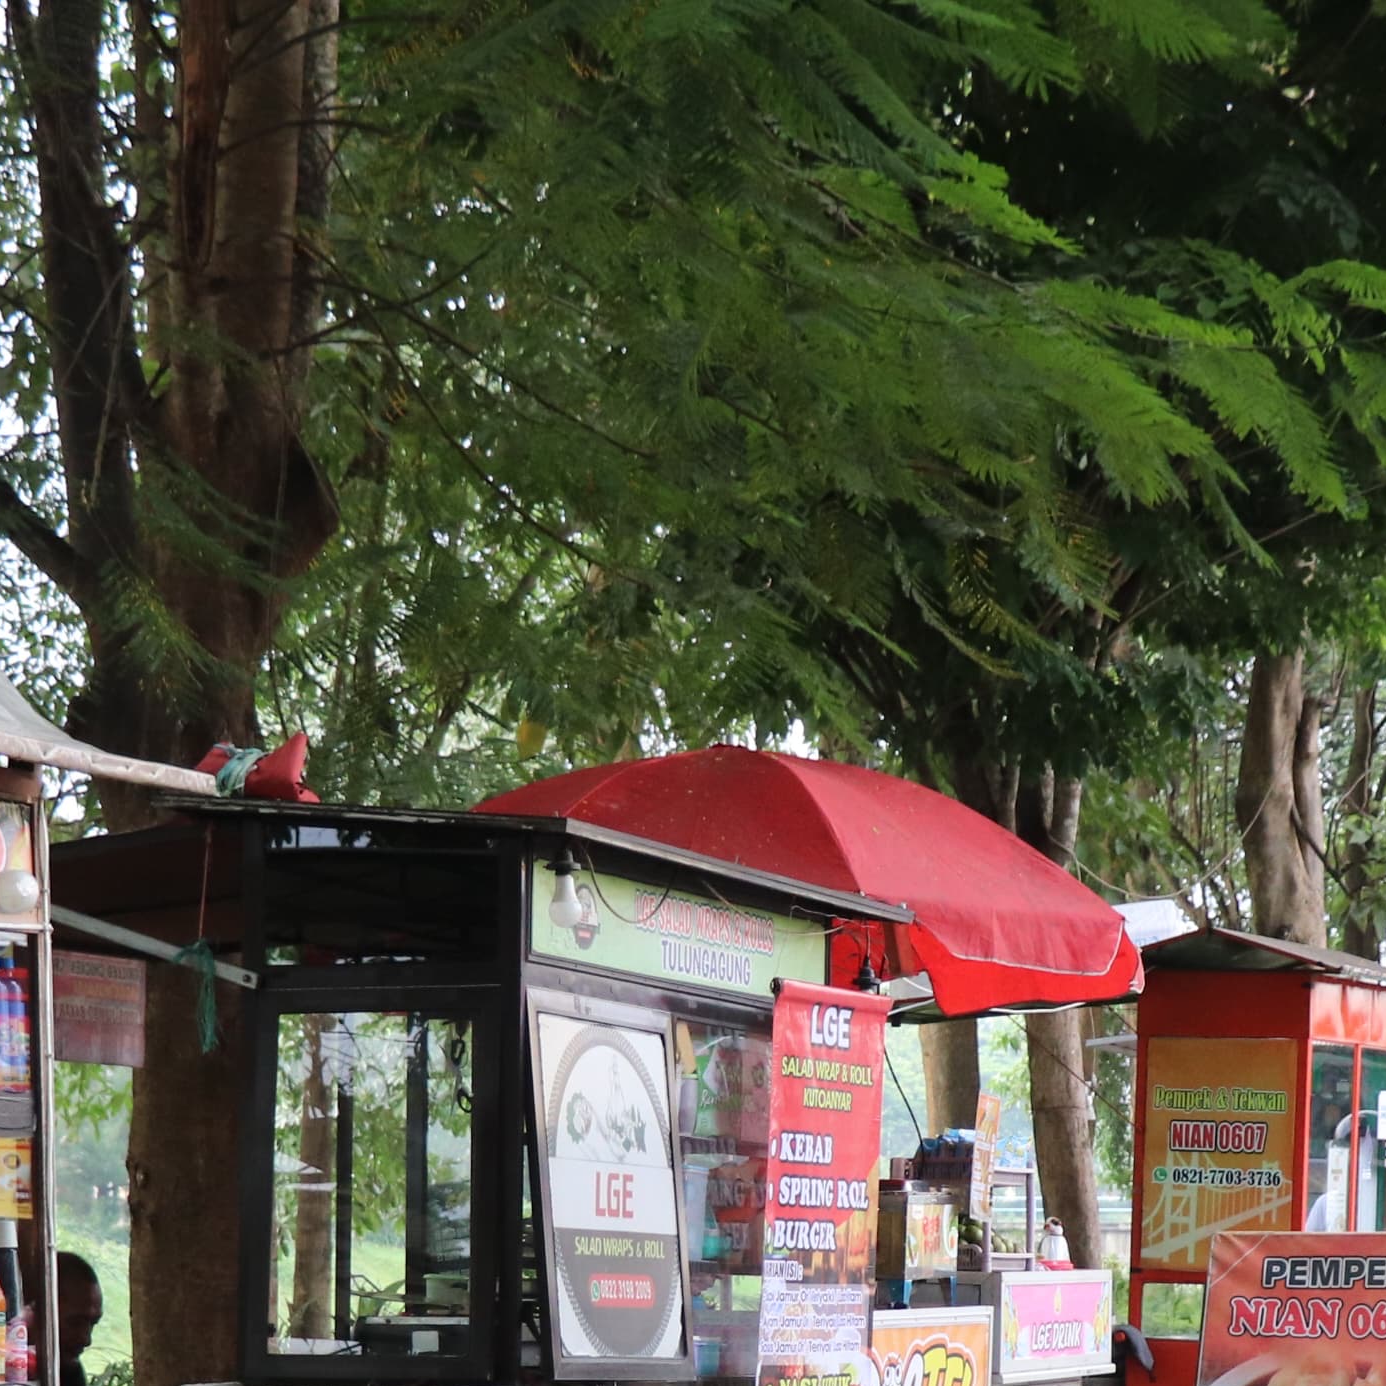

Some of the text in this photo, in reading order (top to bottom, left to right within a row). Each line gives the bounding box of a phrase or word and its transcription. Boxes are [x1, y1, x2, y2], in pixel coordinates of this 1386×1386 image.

[660, 895, 692, 936] SALAD
[696, 903, 731, 943] WRAPS
[734, 917, 741, 947] &
[744, 914, 774, 953] ROLLS
[662, 939, 750, 985] TULUNGAGUNG
[810, 1004, 852, 1049] LGE
[782, 1056, 873, 1086] SALAD WRAP & ROLL
[1155, 1087, 1287, 1112] Pempek & Tekwan
[780, 1132, 833, 1164] KEBAB
[1170, 1121, 1267, 1152] NIAN 0607
[779, 1176, 834, 1208] SPRING
[1173, 1168, 1281, 1186] 0821-7703-3736
[595, 1171, 634, 1218] LGE
[575, 1236, 602, 1255] SALAD
[604, 1238, 633, 1257] WRAPS
[644, 1240, 665, 1259] ROLL
[773, 1220, 836, 1250] BURGER
[1229, 1297, 1342, 1337] NIAN
[1031, 1321, 1081, 1350] LGE DRINK
